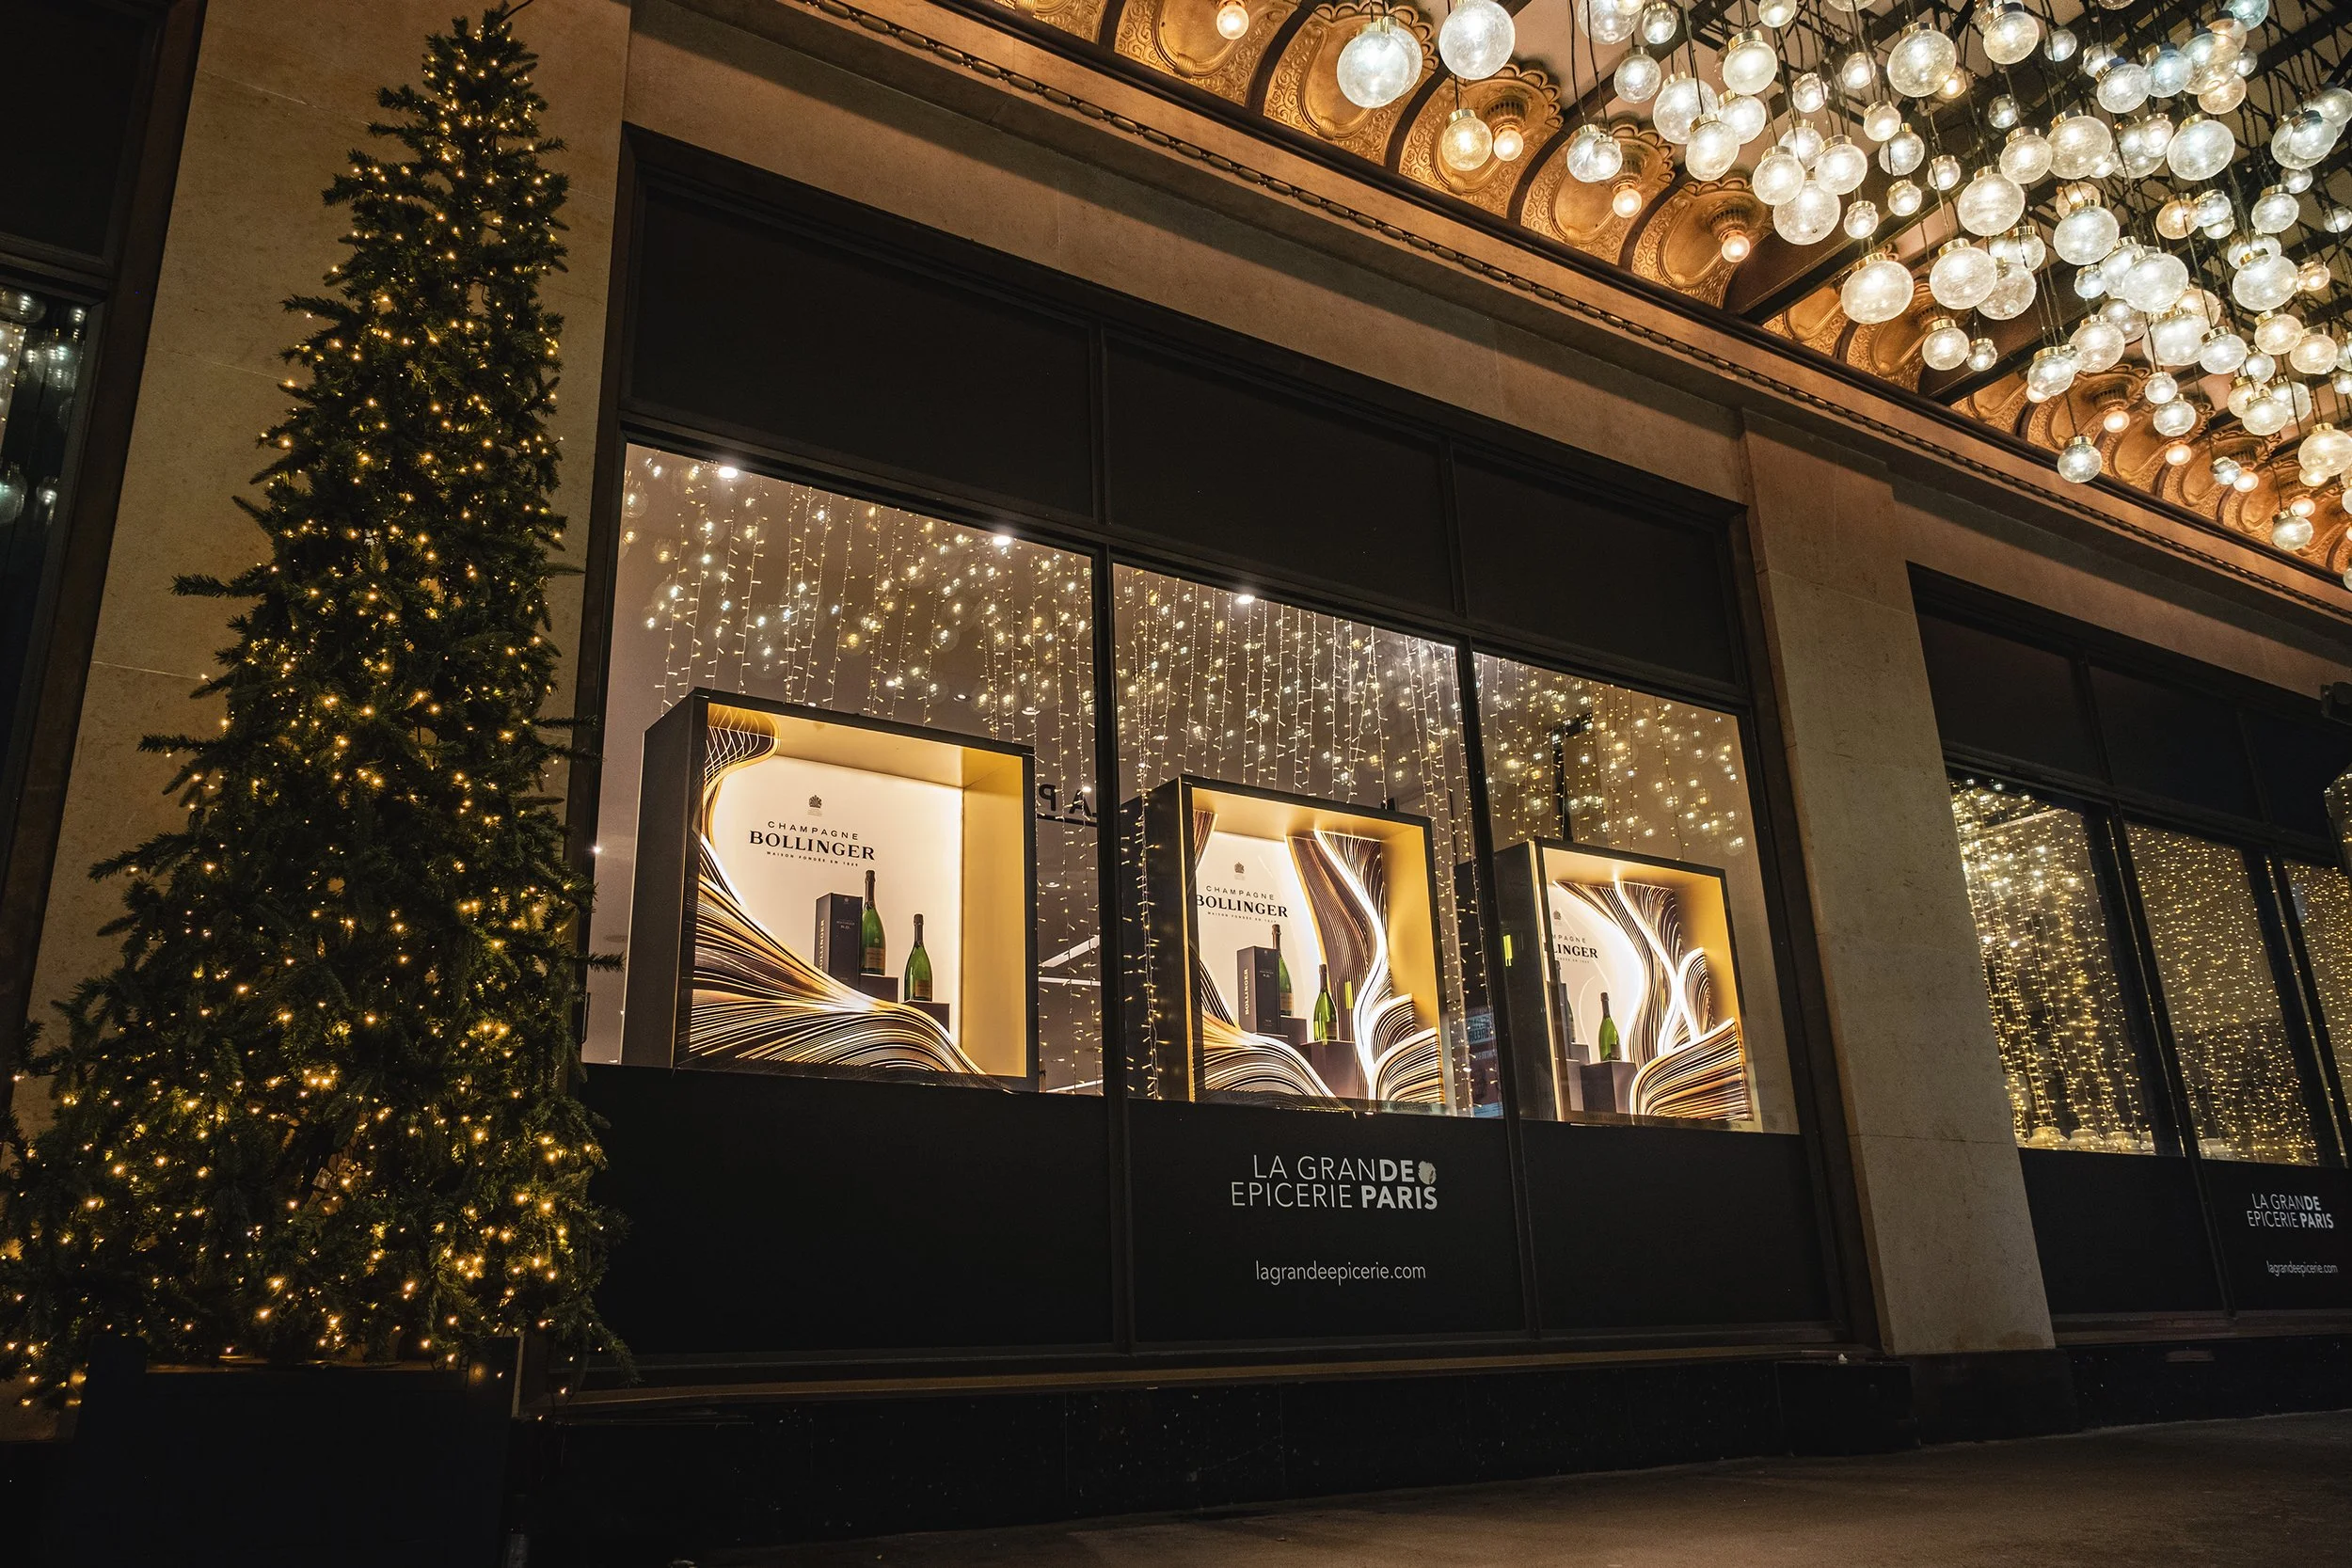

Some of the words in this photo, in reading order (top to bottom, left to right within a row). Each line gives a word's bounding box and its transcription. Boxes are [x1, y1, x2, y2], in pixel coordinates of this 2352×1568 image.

[768, 820, 859, 840] CHAMPAGNE
[750, 830, 876, 861] BOLLINGER
[1205, 885, 1274, 900] CHAMPAGNE
[1197, 895, 1288, 918] BOLLINGER
[1253, 1154, 1288, 1179] LA
[1297, 1155, 1415, 1182] GRANDE
[1231, 1181, 1353, 1209] EPICERIE
[1360, 1185, 1438, 1211] PARIS
[2251, 1193, 2269, 1210] LA
[2270, 1194, 2322, 1211] GRANDE
[2247, 1211, 2298, 1227] EPICERIE
[2299, 1212, 2334, 1228] PARIS
[1256, 1259, 1426, 1286] lagrandeepicerie.com
[2266, 1260, 2338, 1276] lagrandeepicerie.com
